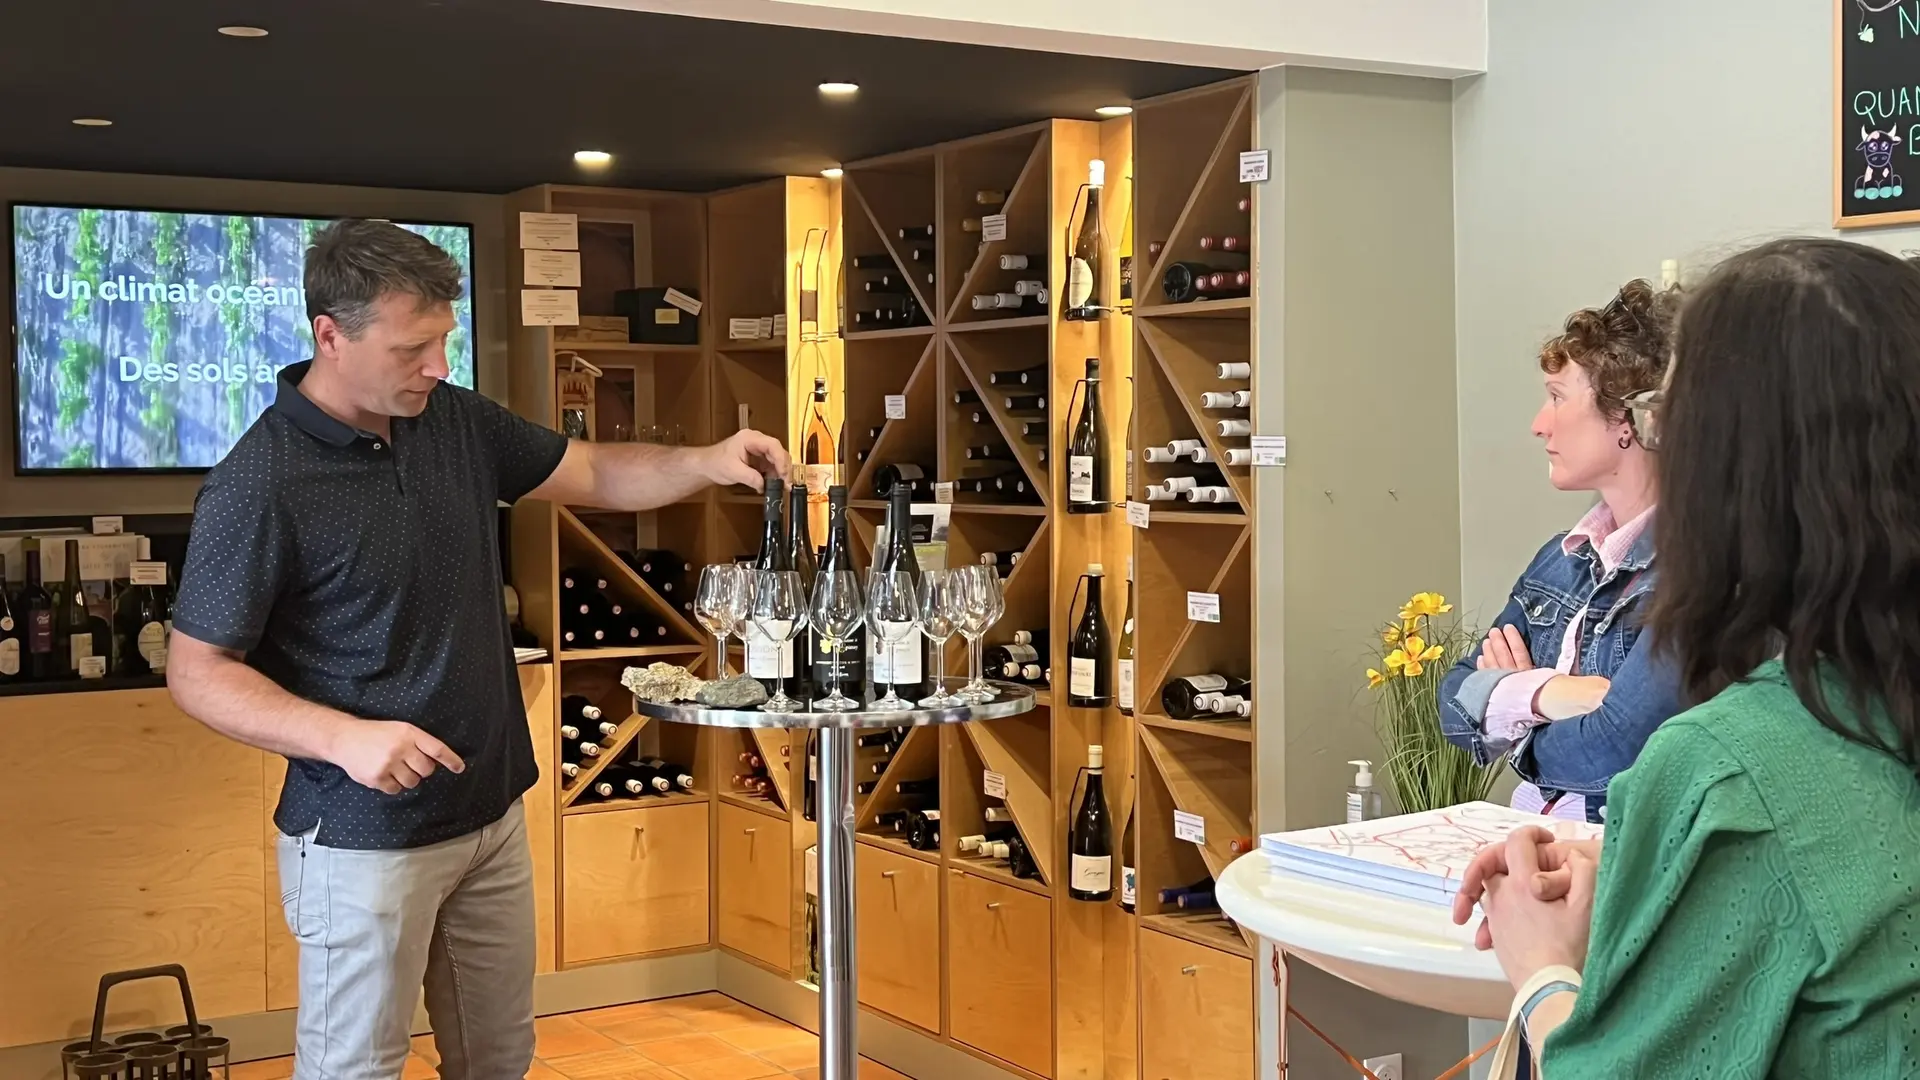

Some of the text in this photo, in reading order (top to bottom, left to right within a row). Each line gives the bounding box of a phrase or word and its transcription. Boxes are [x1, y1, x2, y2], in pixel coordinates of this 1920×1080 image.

[46, 273, 91, 300] Un
[98, 275, 198, 303] climat
[119, 356, 180, 382] Des
[187, 357, 248, 384] sols
